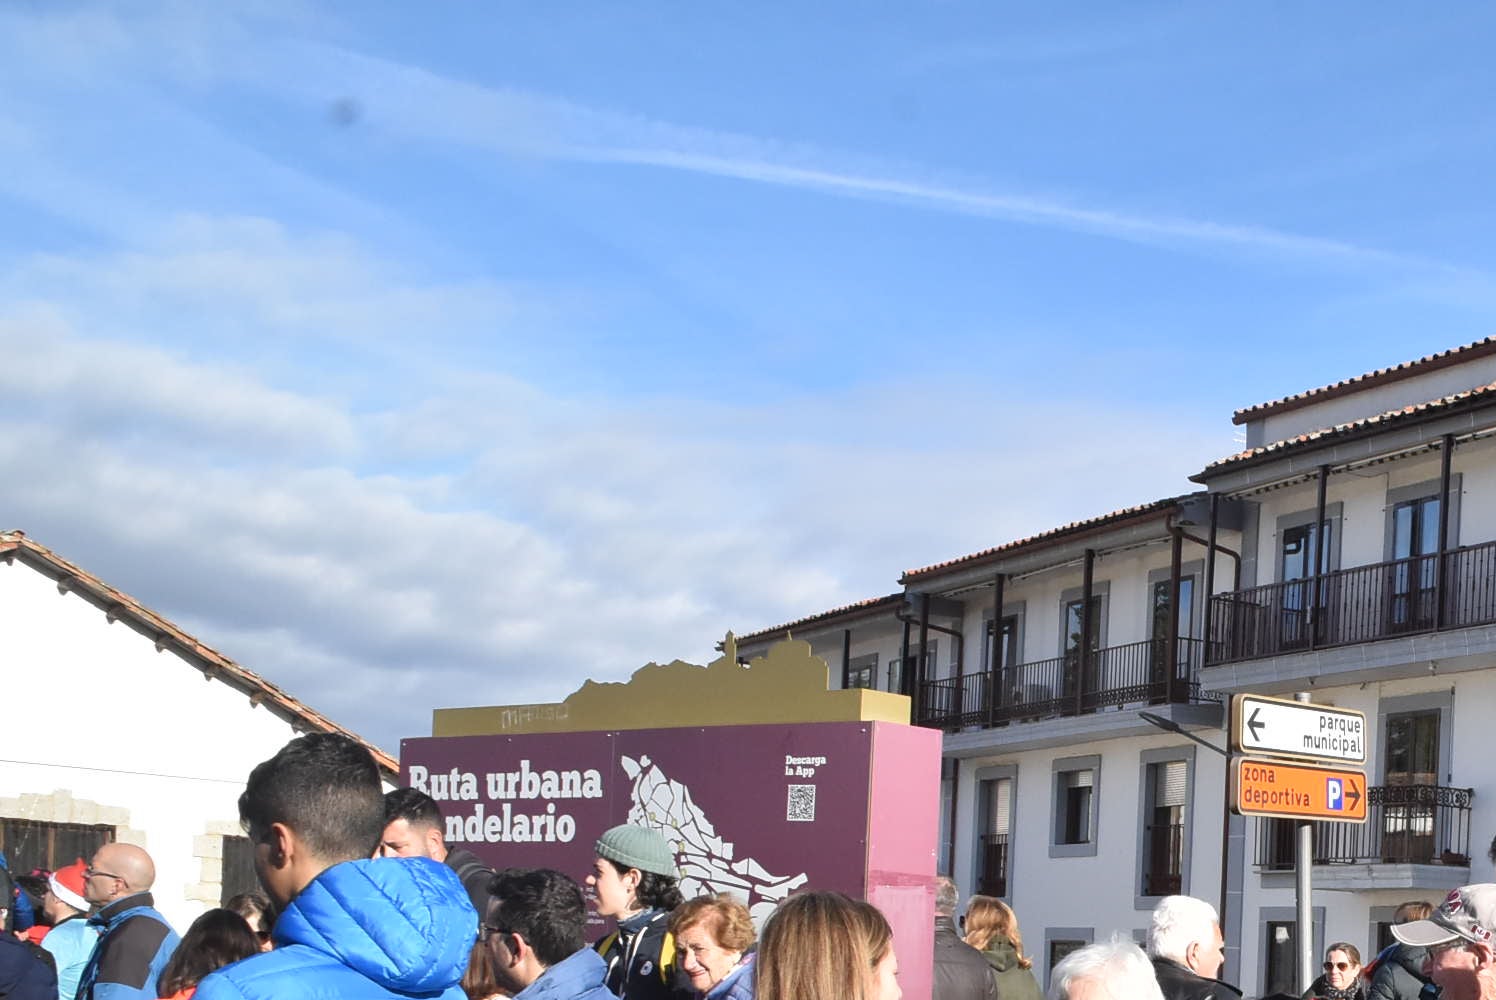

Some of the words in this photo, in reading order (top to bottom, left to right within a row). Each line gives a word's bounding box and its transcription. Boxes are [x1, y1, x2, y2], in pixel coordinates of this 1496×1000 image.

[1319, 715, 1361, 736] parque
[1303, 733, 1361, 755] municipal
[785, 754, 827, 767] Descarga
[409, 765, 479, 800] Ruta
[486, 759, 603, 800] urbana
[785, 765, 794, 776] la
[795, 765, 815, 778] App
[1244, 767, 1275, 783] zona
[1244, 786, 1310, 808] deportiva
[1328, 780, 1340, 809] P
[444, 802, 576, 843] ndelario
